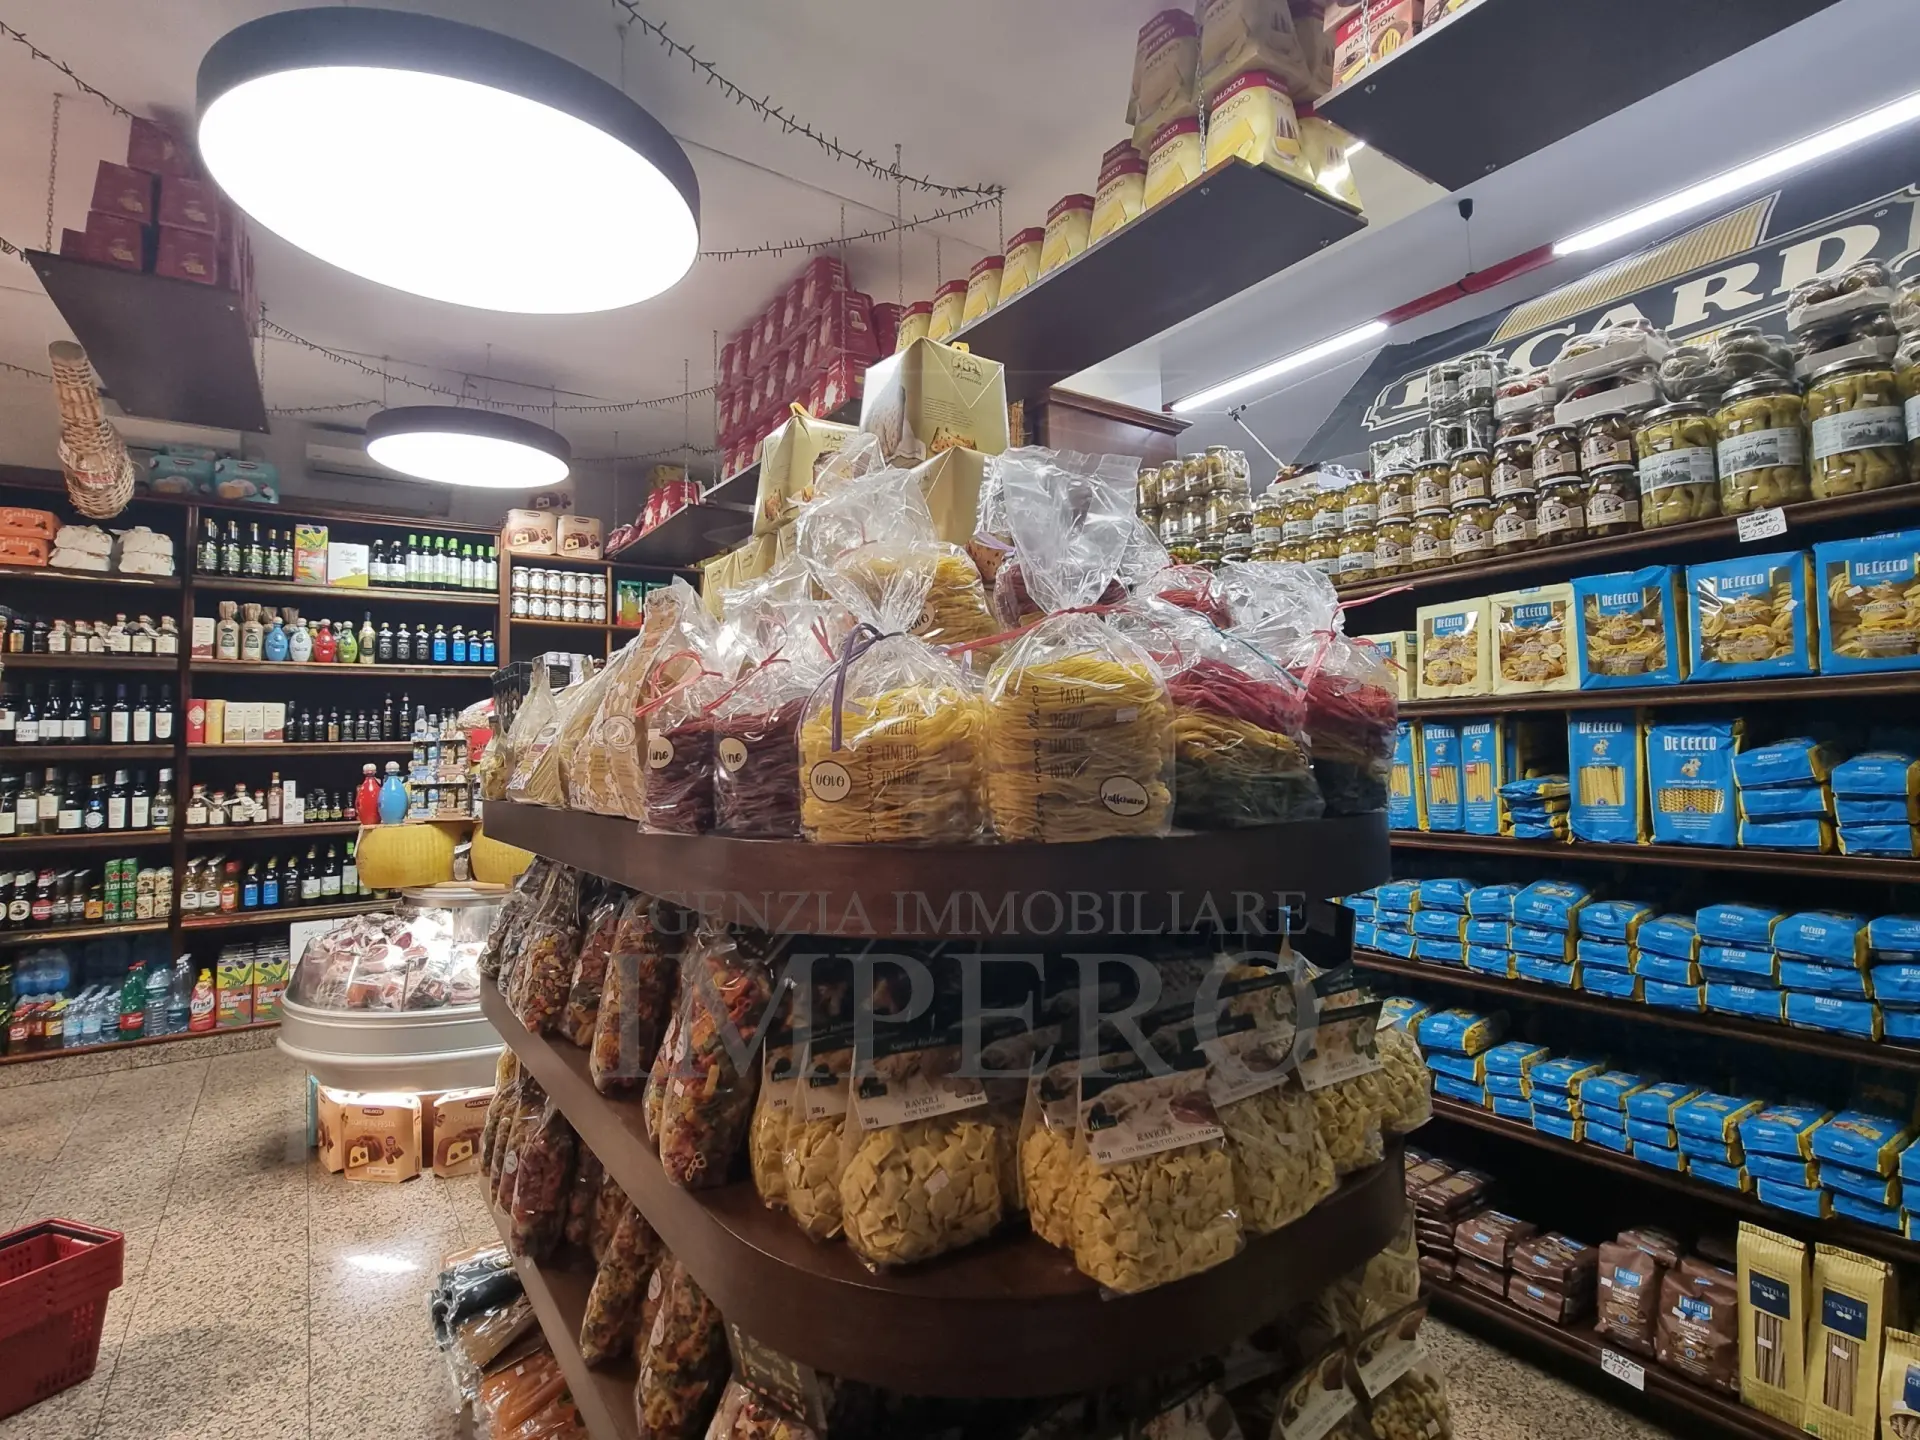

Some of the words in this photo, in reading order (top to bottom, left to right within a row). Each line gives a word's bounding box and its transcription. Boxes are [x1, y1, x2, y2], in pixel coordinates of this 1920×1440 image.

[1855, 561, 1870, 576] DE
[1721, 577, 1733, 590] DE
[1060, 687, 1085, 703] PASTA
[1664, 736, 1678, 751] DE
[1681, 736, 1717, 750] CECCO
[905, 1095, 940, 1109] RAVIOLI
[1751, 1280, 1788, 1299] GENTILE
[1825, 1300, 1865, 1319] GENTILE
